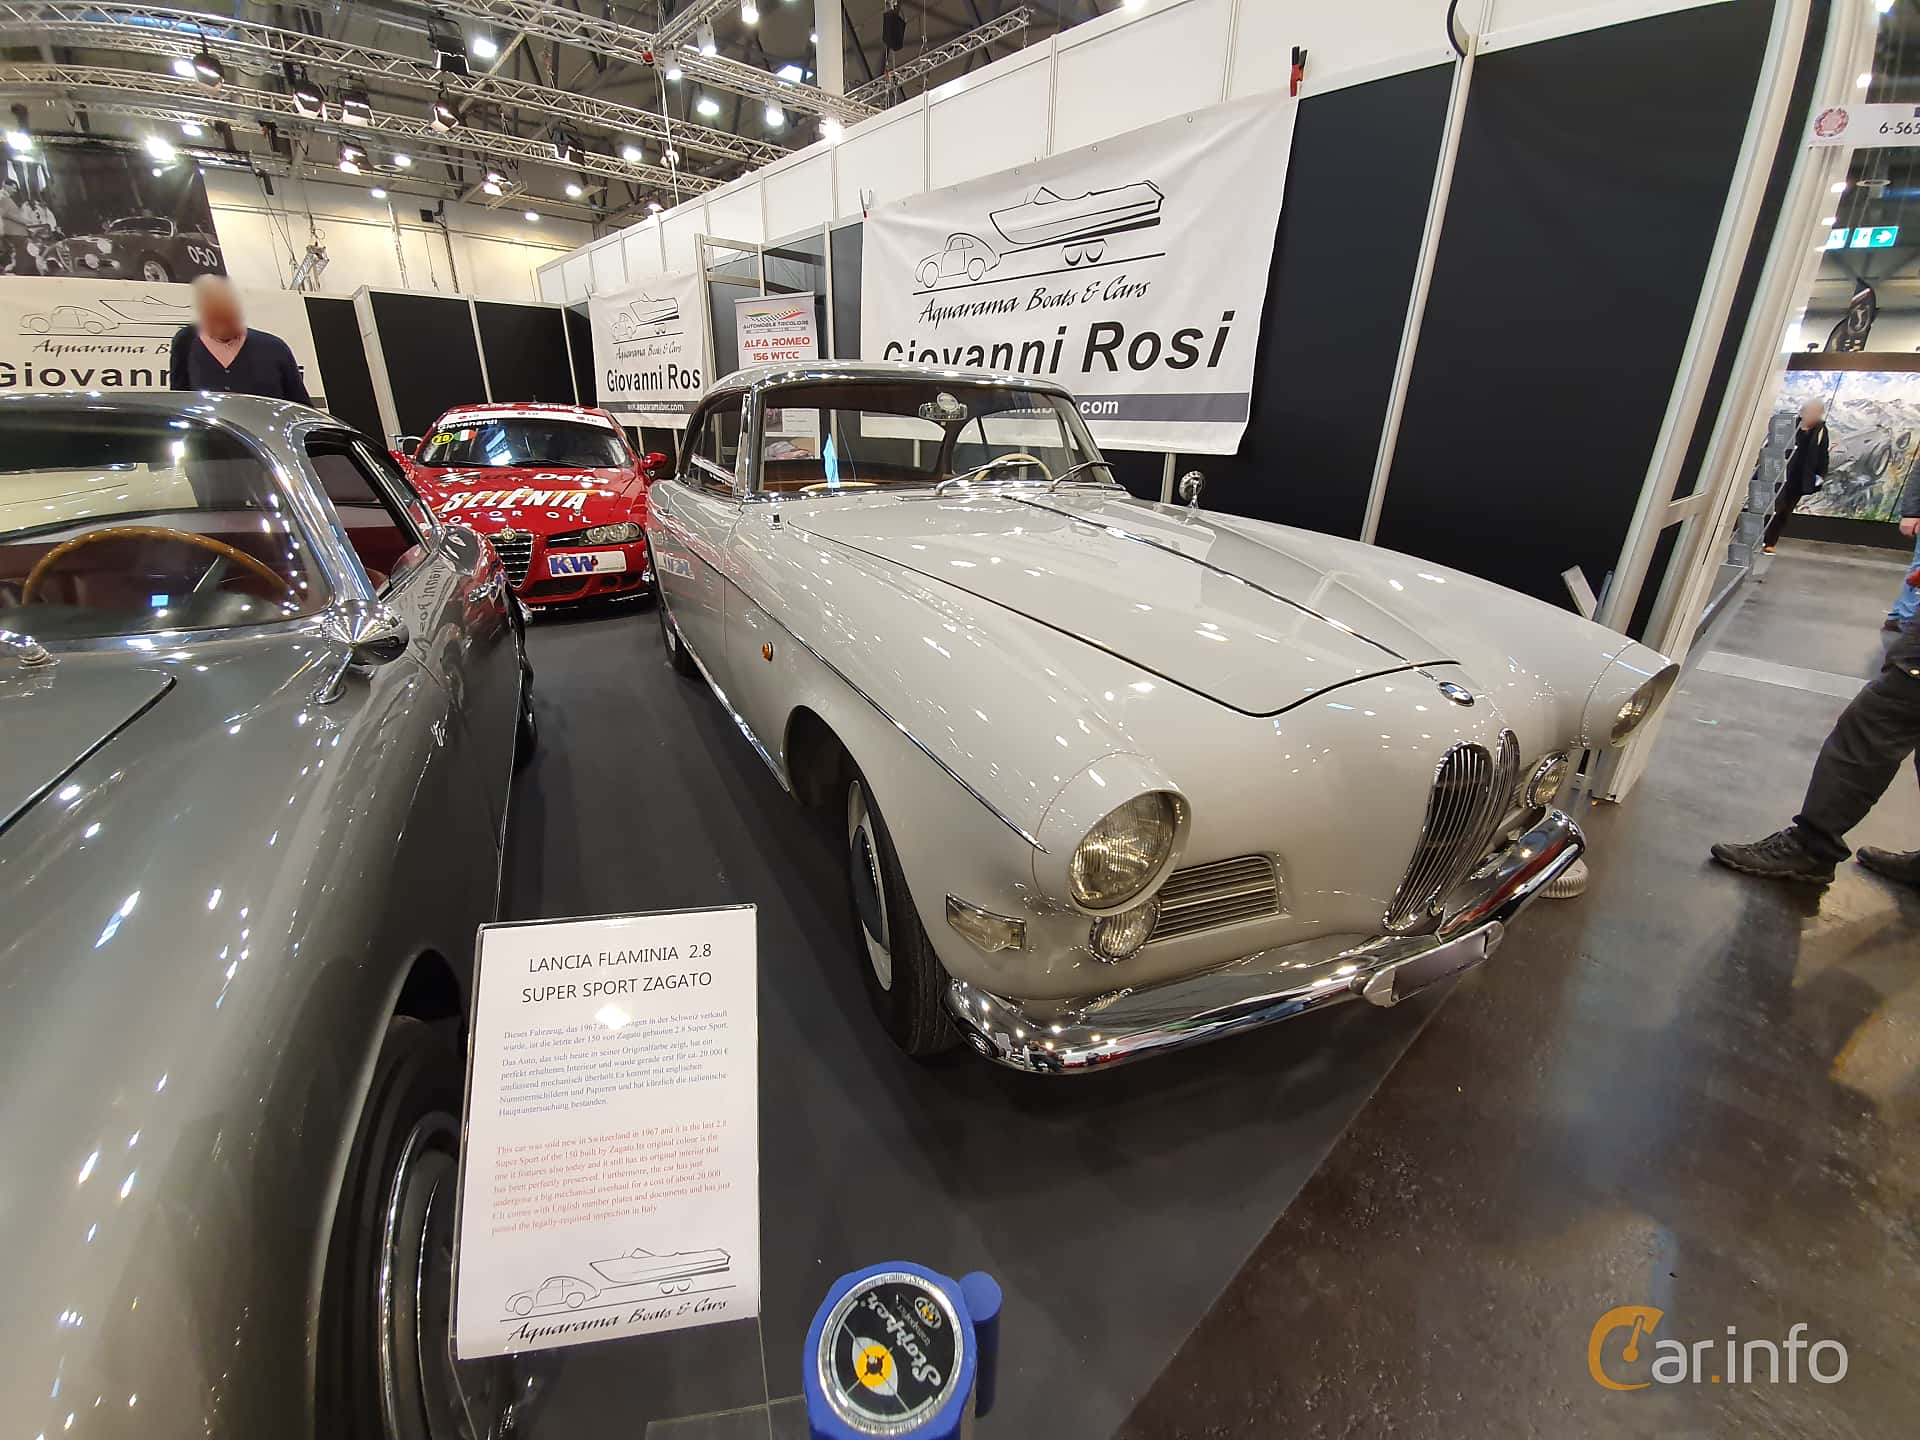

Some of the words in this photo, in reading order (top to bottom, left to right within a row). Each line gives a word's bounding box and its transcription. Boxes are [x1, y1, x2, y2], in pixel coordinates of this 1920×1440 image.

[187, 245, 218, 267] 050
[919, 298, 1019, 330] Aquarama
[1026, 286, 1080, 312] Boats
[1082, 282, 1100, 302] &
[1103, 275, 1151, 302] Cars
[32, 338, 146, 358] Aquarama
[744, 339, 769, 348] ALFA
[772, 337, 810, 346] ROMEO
[753, 353, 769, 361] 156
[771, 351, 800, 360] WTCC
[883, 326, 1067, 375] Giovanni
[1081, 310, 1236, 374] Rosi
[607, 364, 663, 392] Giovanni
[668, 363, 701, 390] Ros
[442, 486, 587, 512] SELENIA
[546, 511, 591, 524] OIL
[529, 953, 592, 973] LANCIA
[598, 946, 679, 967] FLAMINIA
[688, 943, 712, 958] 2.8
[521, 985, 577, 1003] SUPER
[583, 978, 638, 998] SPORT
[643, 972, 712, 991] ZAGATO
[508, 1315, 619, 1344] Aquarama
[627, 1308, 671, 1324] Boats
[676, 1301, 691, 1316] &
[694, 1297, 728, 1313] Cars
